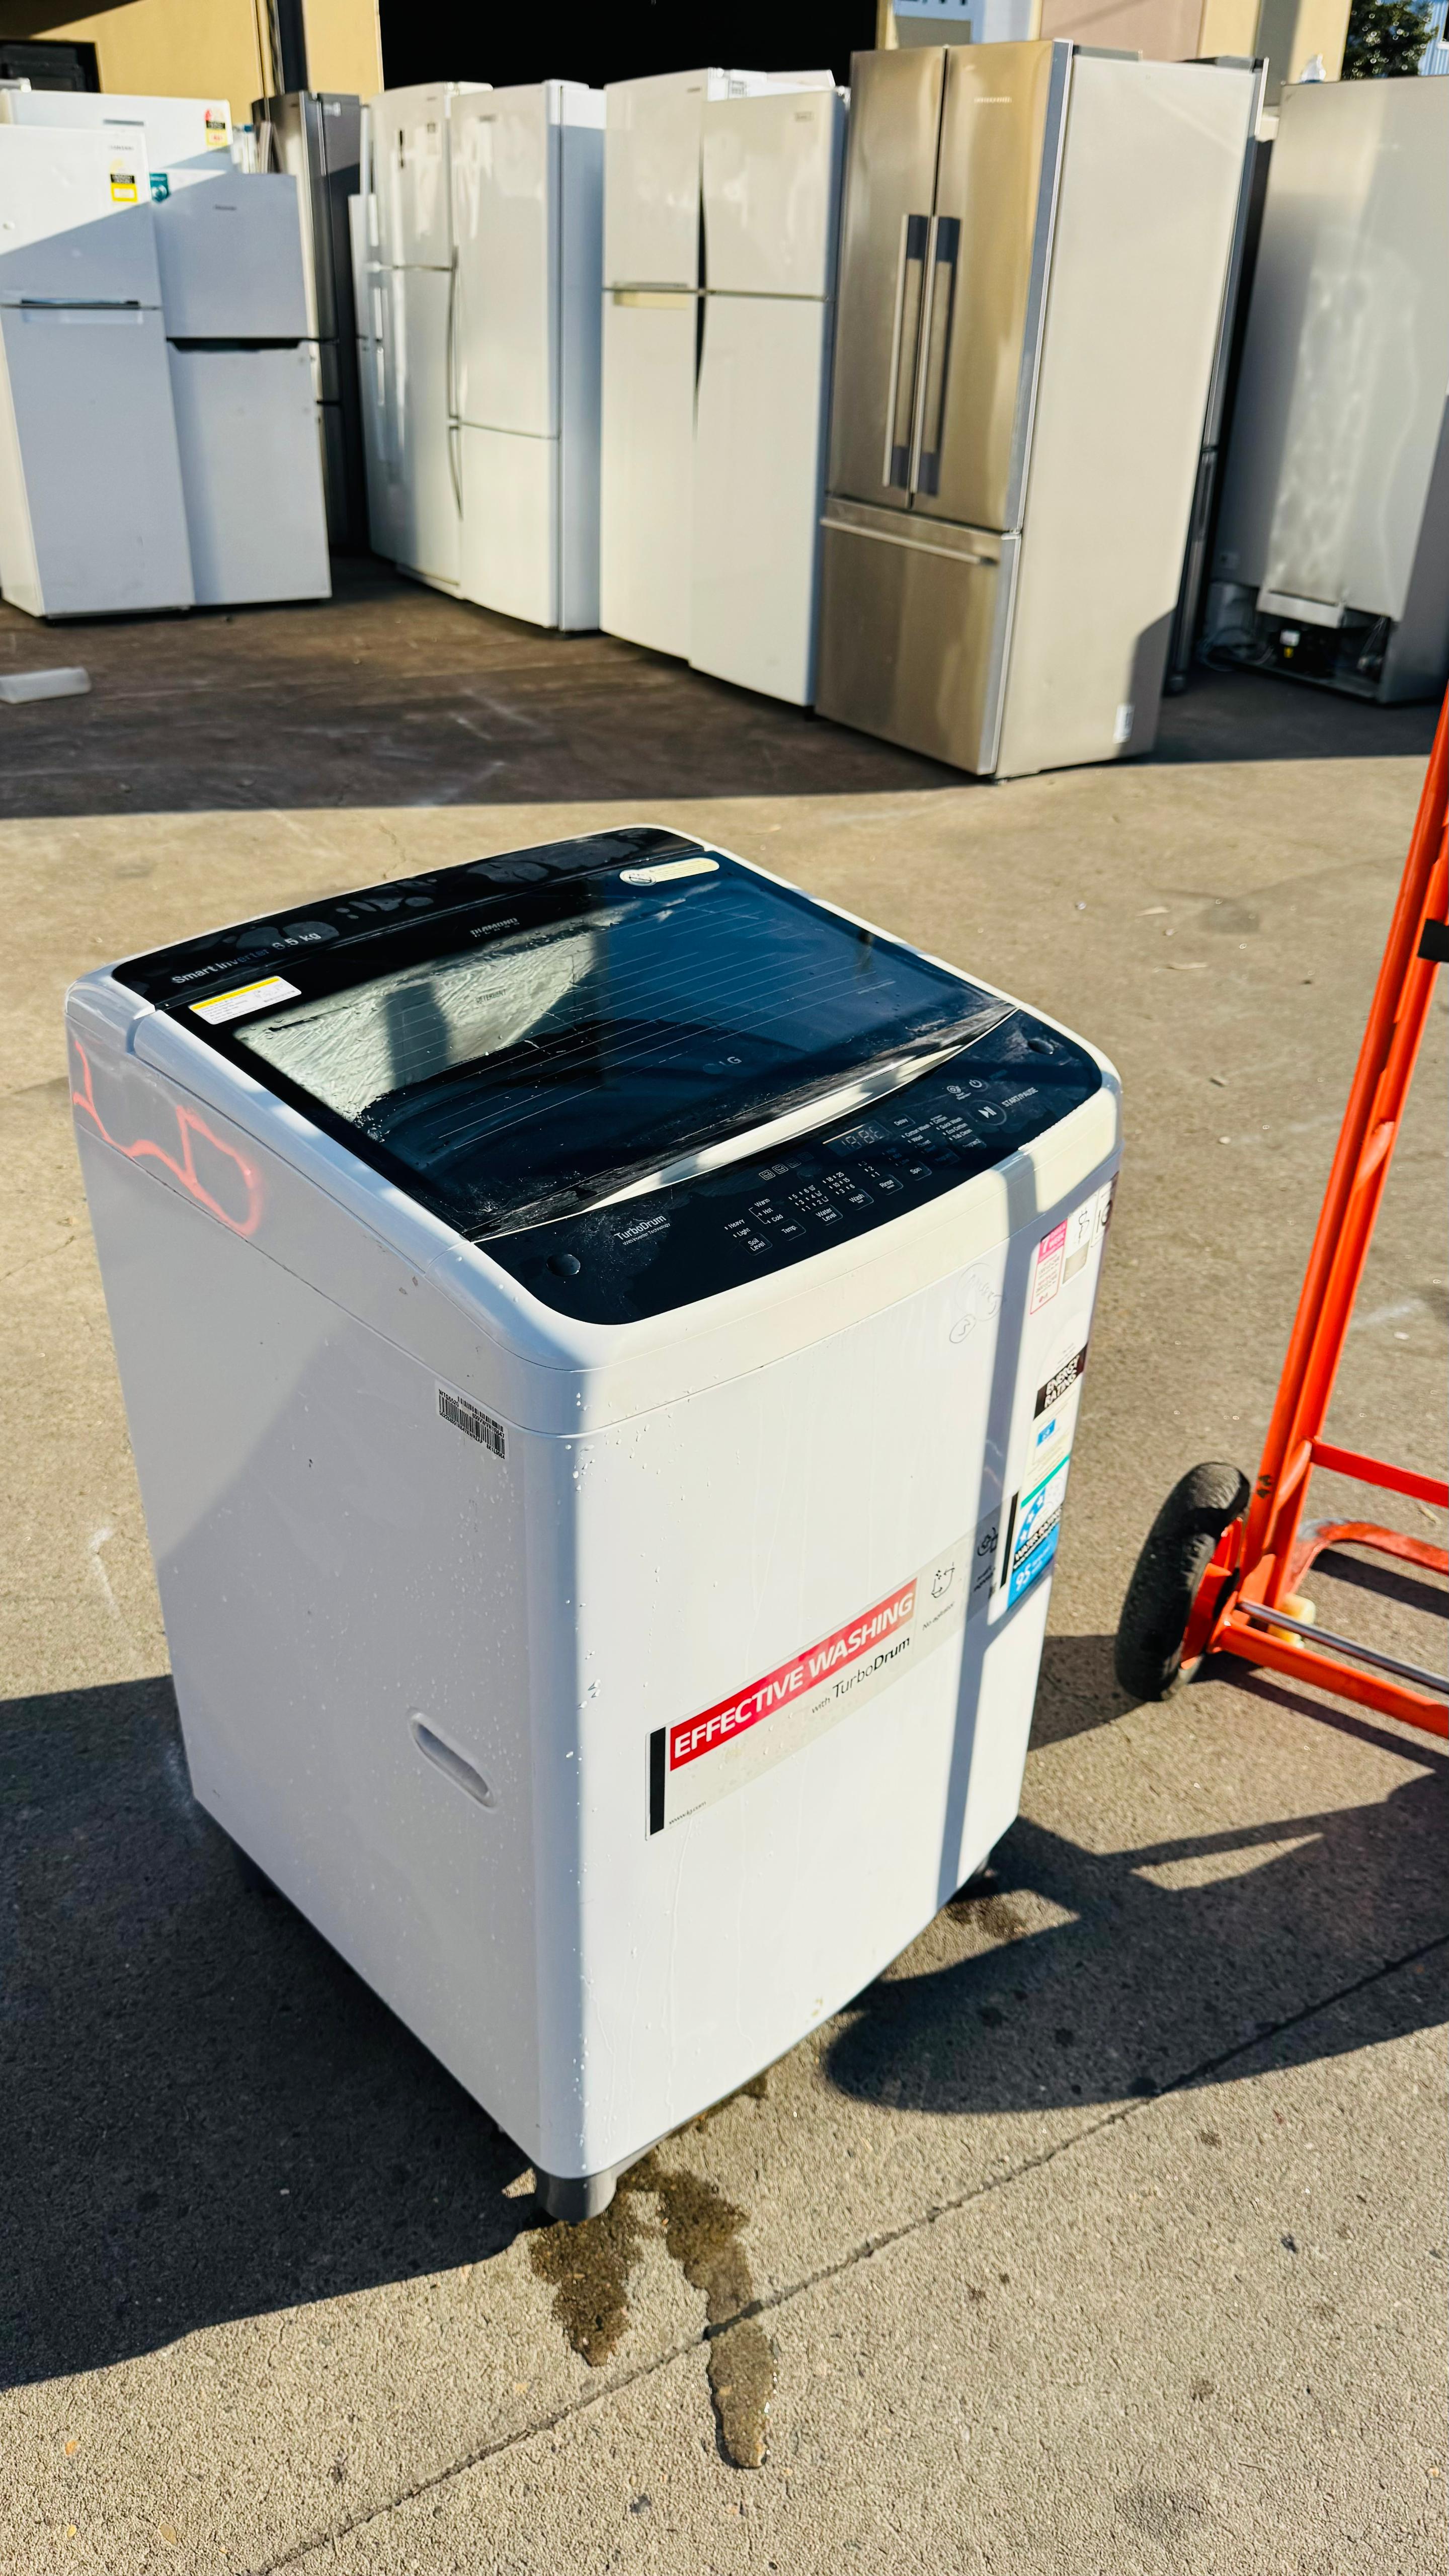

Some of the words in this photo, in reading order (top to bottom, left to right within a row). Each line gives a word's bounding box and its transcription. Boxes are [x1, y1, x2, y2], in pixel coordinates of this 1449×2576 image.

[171, 965, 218, 983] Smart
[215, 949, 270, 970] Inverter
[272, 938, 299, 950] 6.5
[299, 932, 321, 942] kg
[754, 1198, 770, 1207] Warm
[849, 1193, 865, 1202] Wash
[816, 1208, 832, 1217] Water
[822, 1212, 837, 1222] Level
[614, 1215, 667, 1241] TurboDrum
[728, 1219, 745, 1229] Heavy
[737, 1228, 751, 1236] Light
[750, 1241, 766, 1251] Level
[674, 1665, 803, 1758] EFFECTIVE
[808, 1592, 914, 1678] WASHING
[812, 1697, 831, 1714] with
[832, 1637, 910, 1698] TurboDrum
